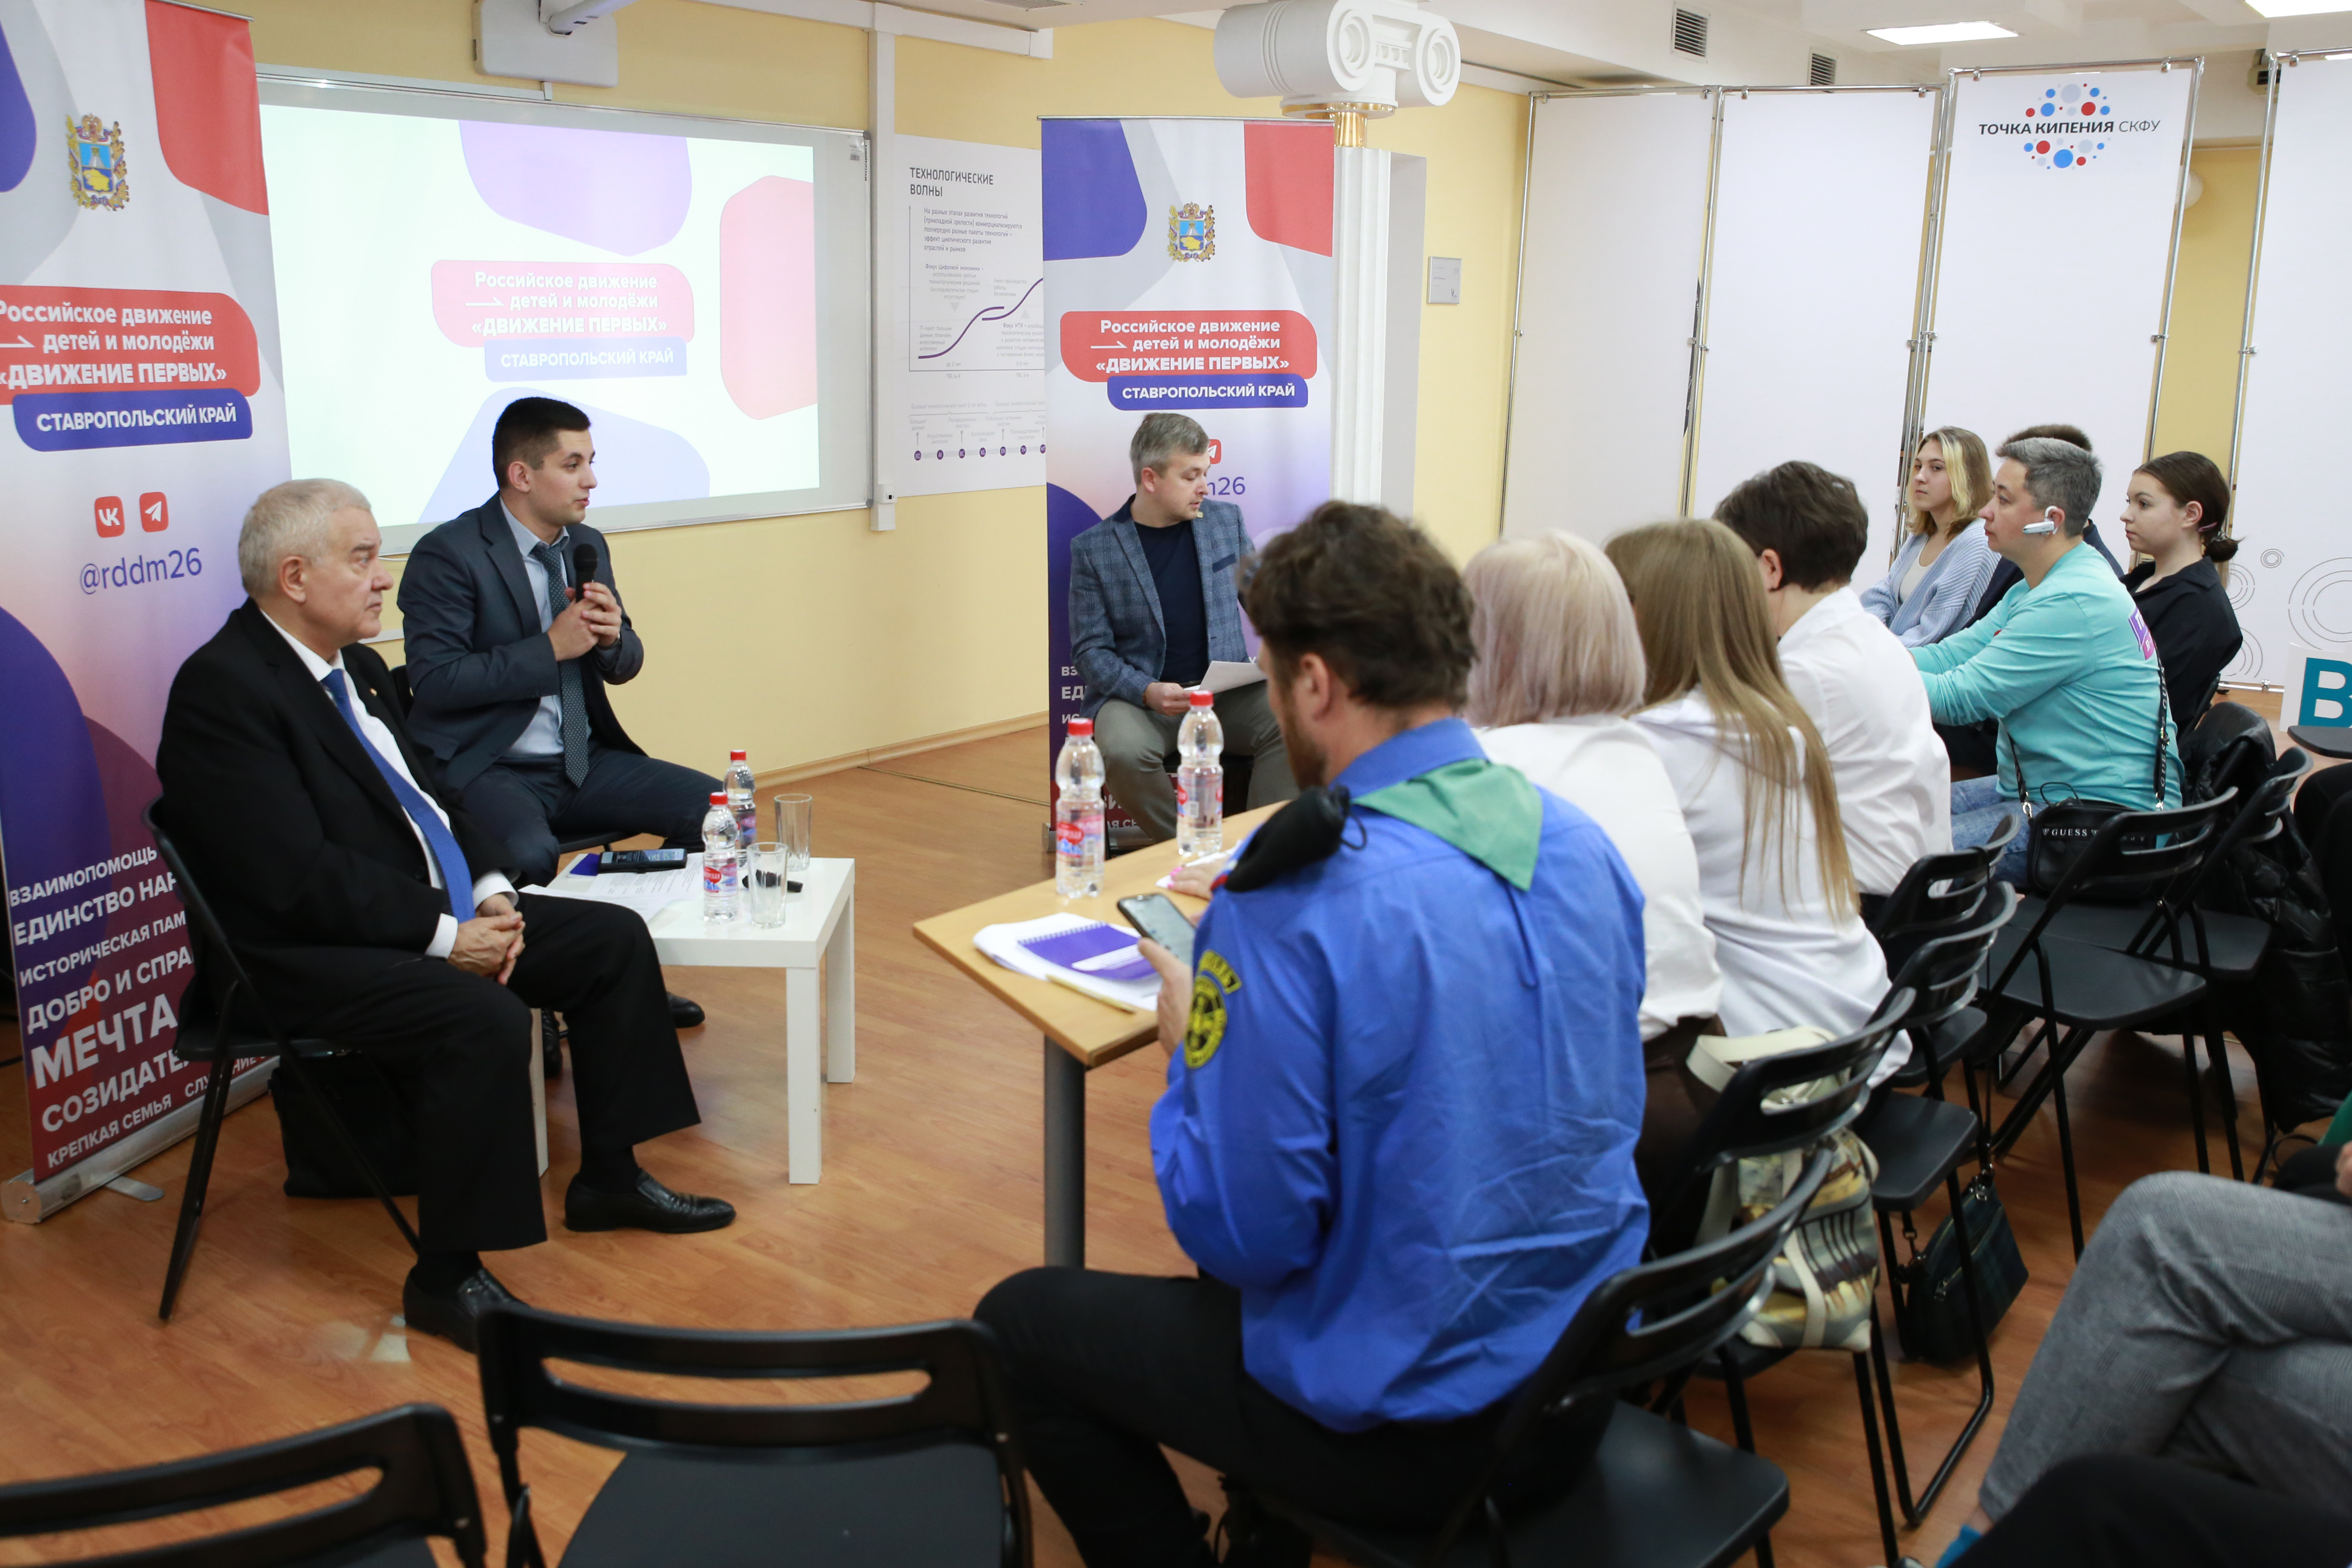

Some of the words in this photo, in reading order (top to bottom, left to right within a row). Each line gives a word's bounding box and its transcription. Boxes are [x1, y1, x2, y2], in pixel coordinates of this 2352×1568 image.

[1979, 123, 2031, 134] ТОЧКА
[2035, 121, 2115, 134] КИПЕНИЯ
[2119, 120, 2161, 133] СКФУ
[910, 167, 994, 185] ТЕХНОЛОГИЧЕСКИЕ
[910, 184, 942, 197] ВОЛНЫ
[924, 216, 952, 225] (прикладной
[975, 221, 1022, 229] коммерциализируются
[474, 271, 574, 289] Российское
[578, 275, 658, 290] движение
[510, 293, 558, 311] детей
[562, 296, 572, 308] и
[577, 292, 658, 310] молодёжи
[121, 308, 212, 327] движение
[471, 318, 584, 336] «ДВИЖЕНИЕ
[589, 316, 667, 332] ПЕРВЫХ»
[1101, 319, 1195, 334] Российское
[1199, 321, 1281, 334] движение
[43, 330, 100, 354] детей
[106, 335, 117, 350] и
[122, 330, 214, 354] молодёжи
[1133, 336, 1179, 352] детей
[1184, 339, 1194, 349] и
[1198, 335, 1281, 350] молодёжи
[501, 349, 636, 367] СТАВРОПОЛЬСКИЙ
[639, 347, 674, 364] КРАЙ
[1096, 357, 1204, 374] «ДВИЖЕНИЕ
[1209, 356, 1290, 370] ПЕРВЫХ»
[138, 362, 227, 383] ПЕРВЫХ»
[1122, 384, 1255, 399] СТАВРОПОЛЬСКИЙ
[1258, 382, 1295, 397] КРАЙ
[36, 404, 198, 432] СТАВРОПОЛЬСКИЙ
[200, 402, 237, 423] КРАЙ
[80, 547, 202, 595] @rddm26
[2051, 828, 2087, 836] GUESS
[9, 846, 157, 907] ВЗАИМОПОМОЩЬ
[13, 887, 135, 946] ЕДИНСТВО
[20, 925, 150, 987] ИСТОРИЧЕСКАЯ
[28, 979, 111, 1034] ДОБРО
[116, 969, 132, 994] И
[31, 993, 178, 1089] МЕЧТА
[47, 1120, 119, 1169] КРЕПКАЯ
[122, 1094, 172, 1129] СЕМЬЯ
